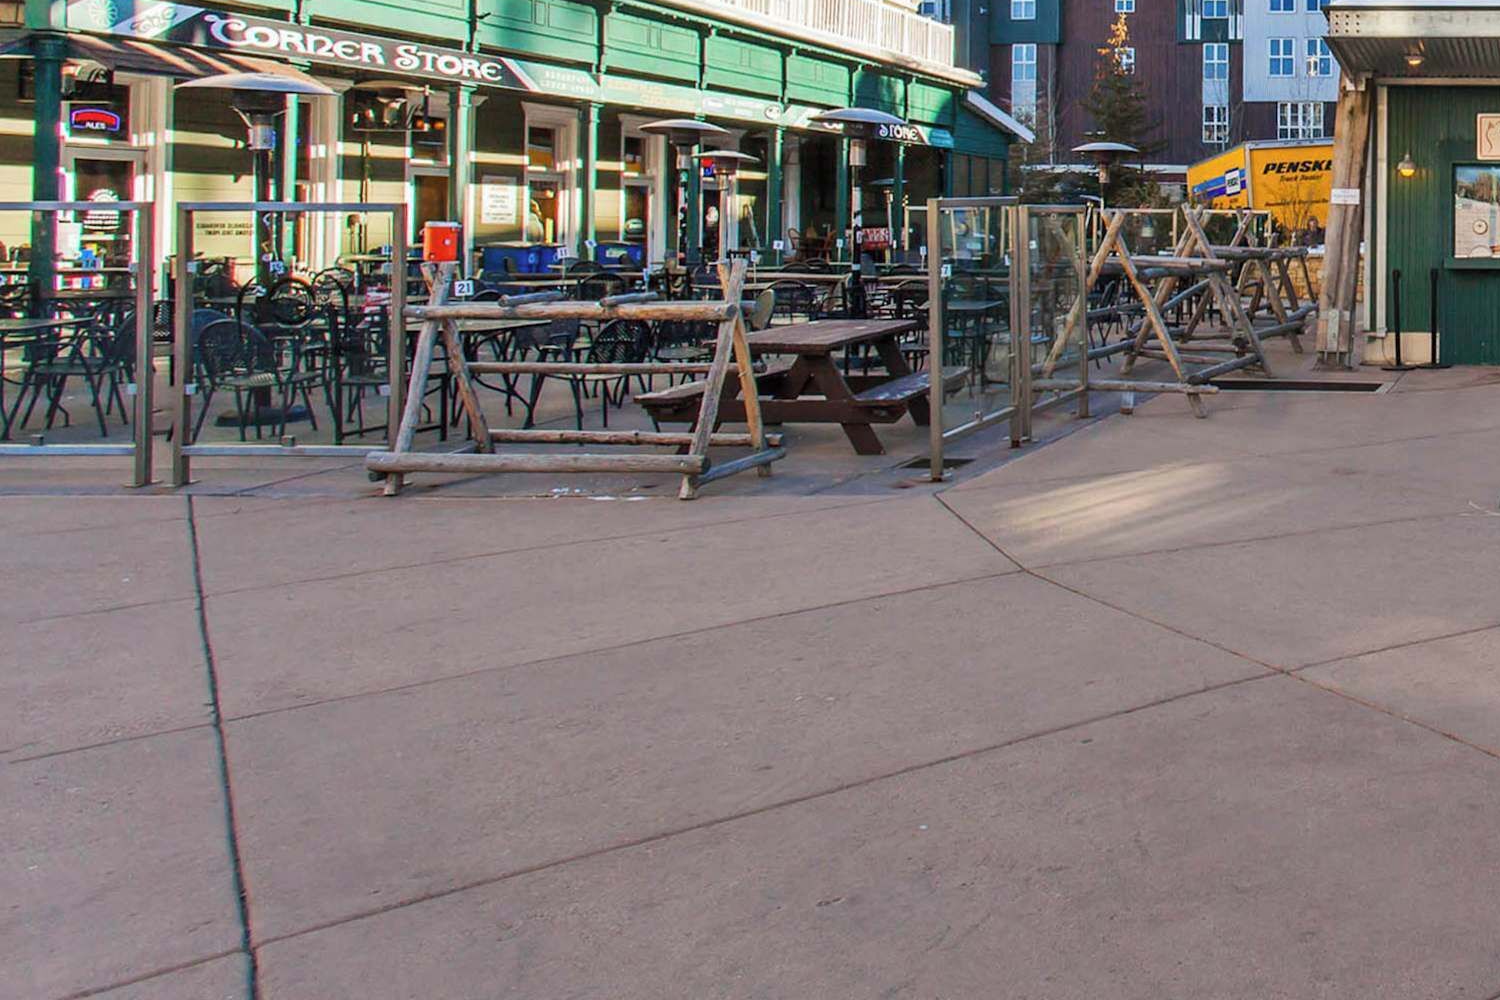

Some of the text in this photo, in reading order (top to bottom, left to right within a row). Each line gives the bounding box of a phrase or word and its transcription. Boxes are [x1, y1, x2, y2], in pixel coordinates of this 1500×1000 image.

[204, 14, 385, 65] CORNER
[395, 45, 503, 81] STORE
[457, 282, 471, 294] 21
